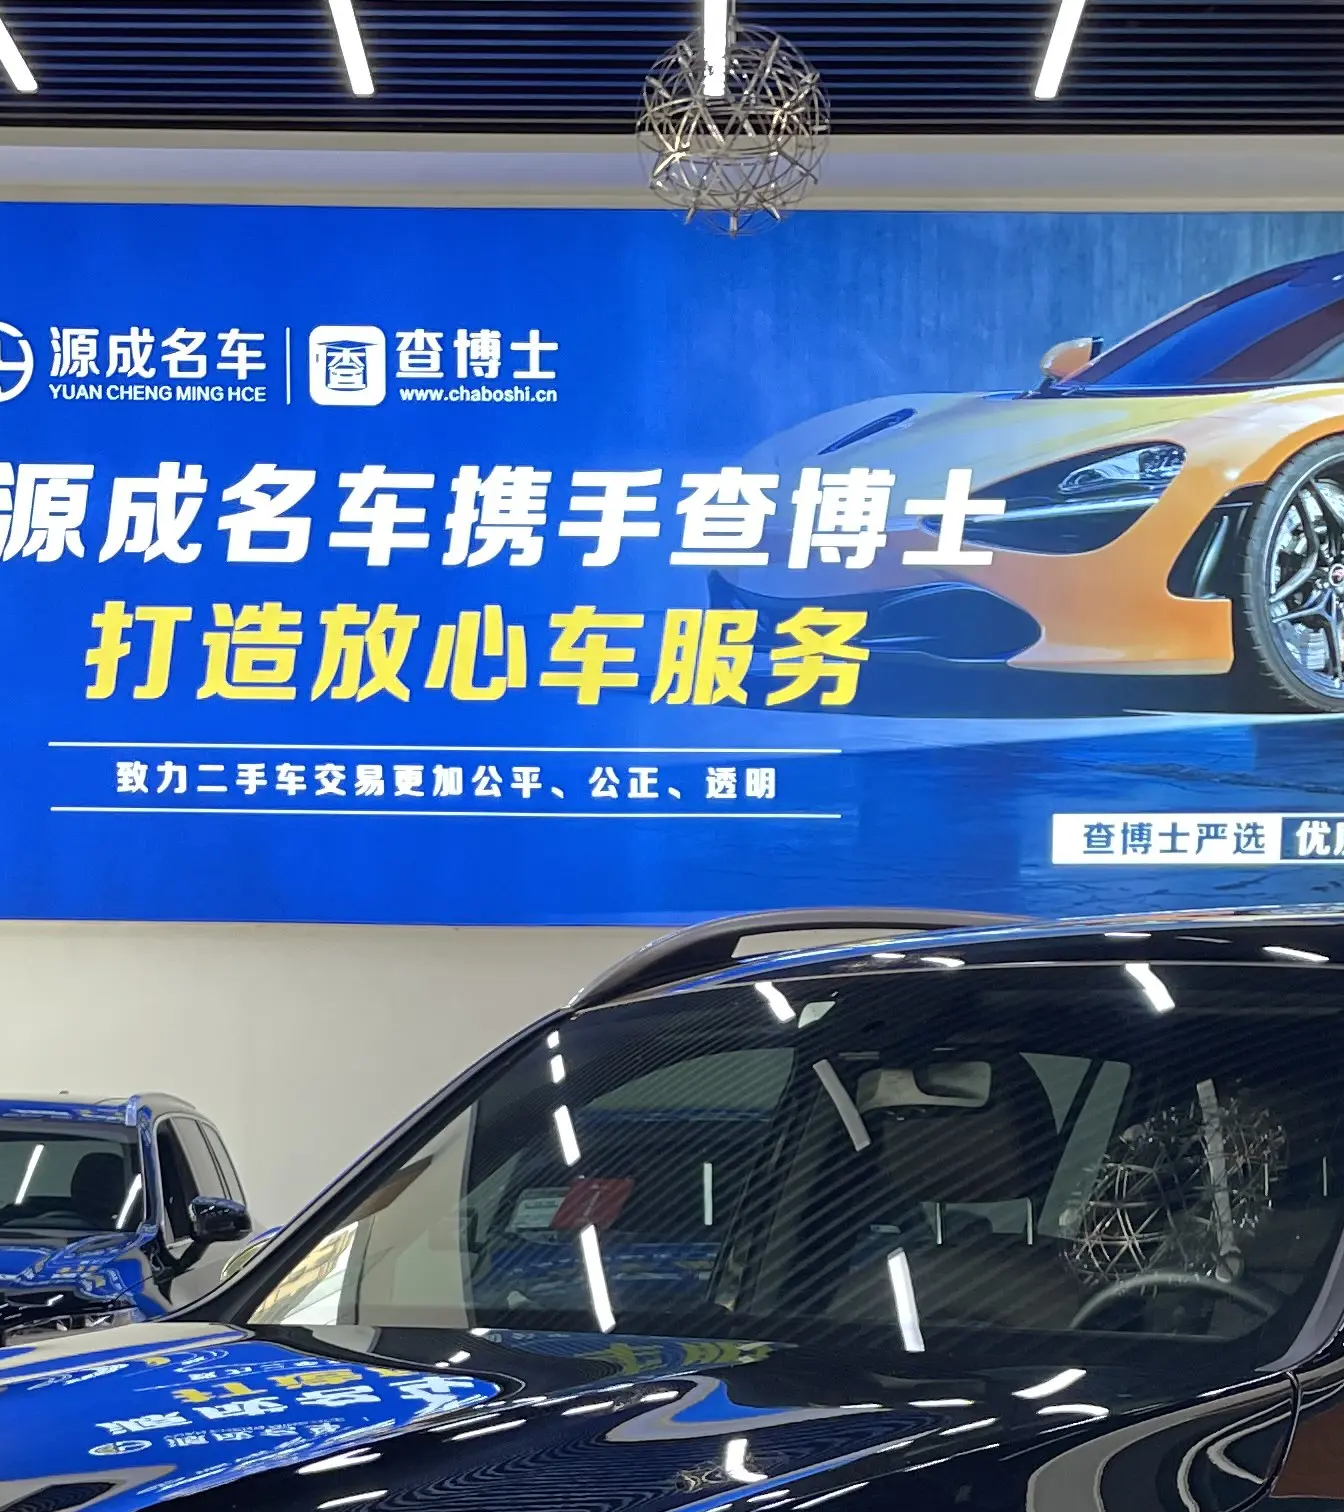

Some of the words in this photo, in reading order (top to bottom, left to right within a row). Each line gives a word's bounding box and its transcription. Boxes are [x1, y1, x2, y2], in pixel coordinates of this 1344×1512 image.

[49, 326, 267, 380] 源成名车
[395, 328, 559, 380] 查博士
[49, 383, 103, 400] YUAN
[105, 384, 173, 401] CHENG
[175, 385, 225, 402] MING
[227, 386, 267, 402] HCE
[399, 384, 558, 404] www.chaboshi.cn
[84, 600, 870, 706] 打造放心车服务
[115, 761, 777, 800] 致力二手车交易更加公平、公正、透明
[1082, 820, 1266, 857] 查博士严选
